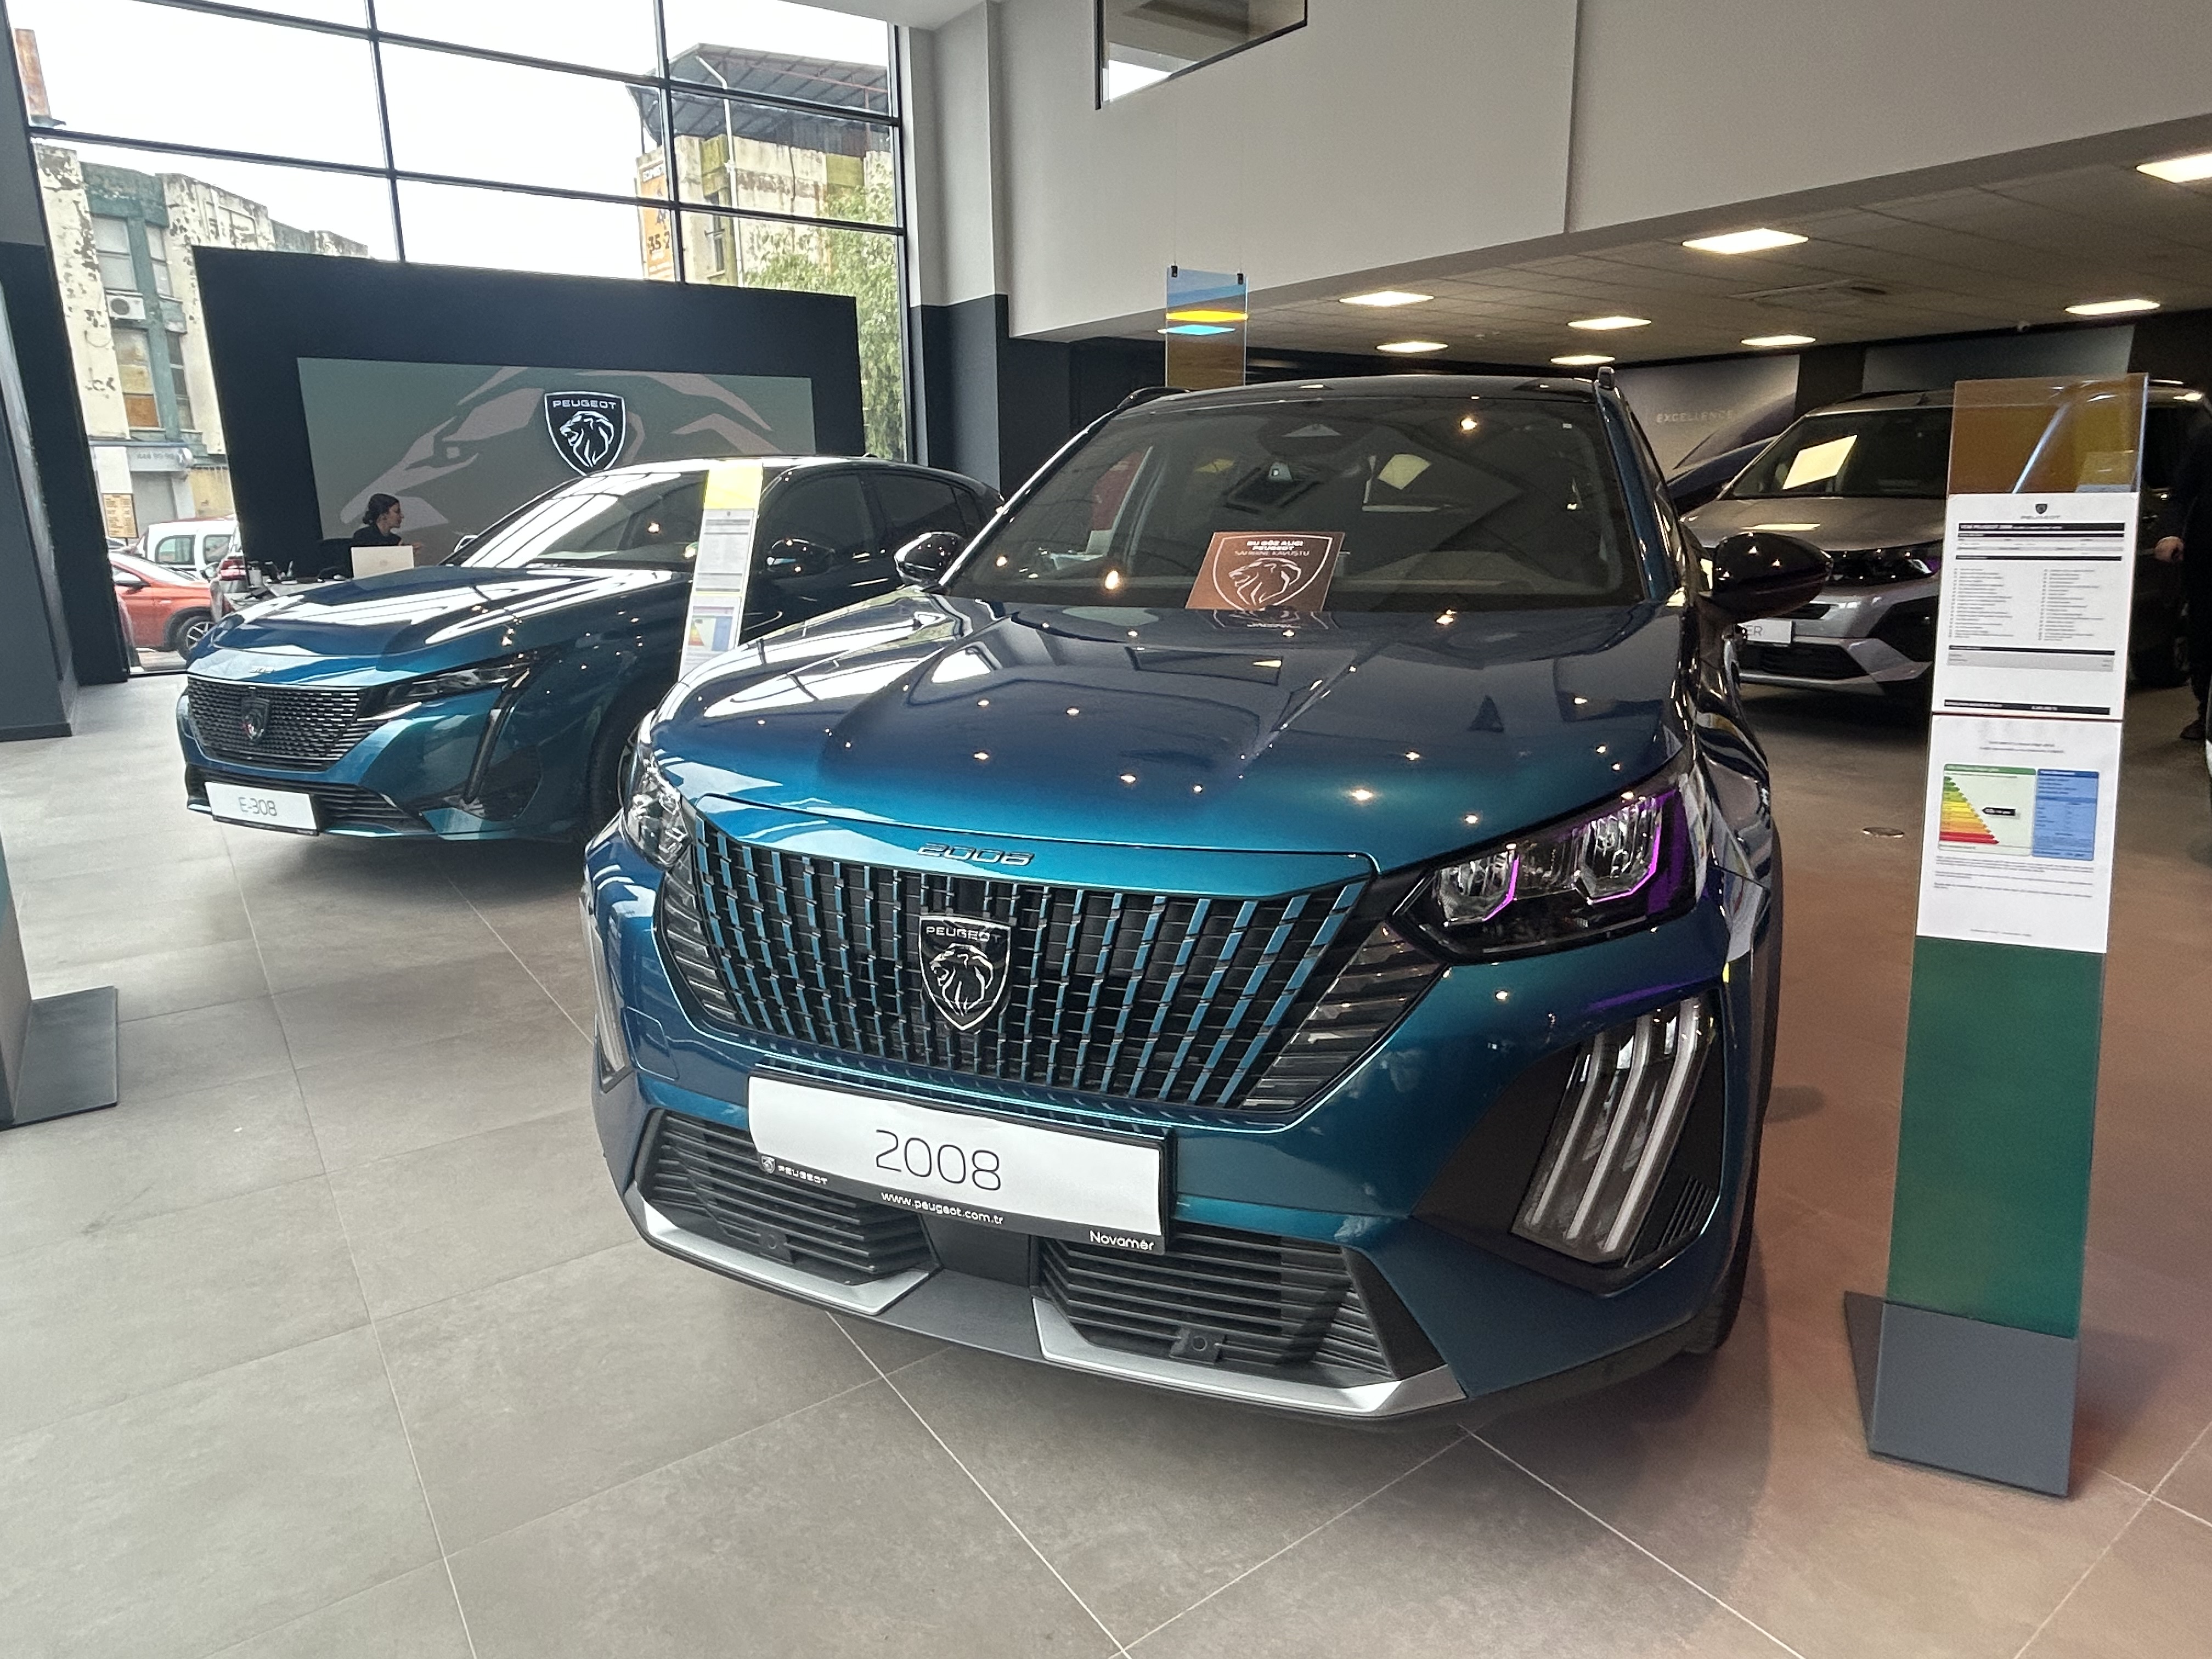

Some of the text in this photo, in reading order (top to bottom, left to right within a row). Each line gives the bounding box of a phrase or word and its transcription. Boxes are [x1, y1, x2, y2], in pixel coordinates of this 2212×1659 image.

[552, 399, 617, 410] PEUGEOT
[238, 797, 278, 816] E-308
[917, 842, 1035, 866] 2008
[926, 926, 1002, 943] PEUGEOT
[876, 1128, 1001, 1190] 2008
[778, 1165, 828, 1185] PEUGEOT
[881, 1192, 1004, 1224] www.peugeot.com.tr
[1090, 1229, 1154, 1251] Novamer
